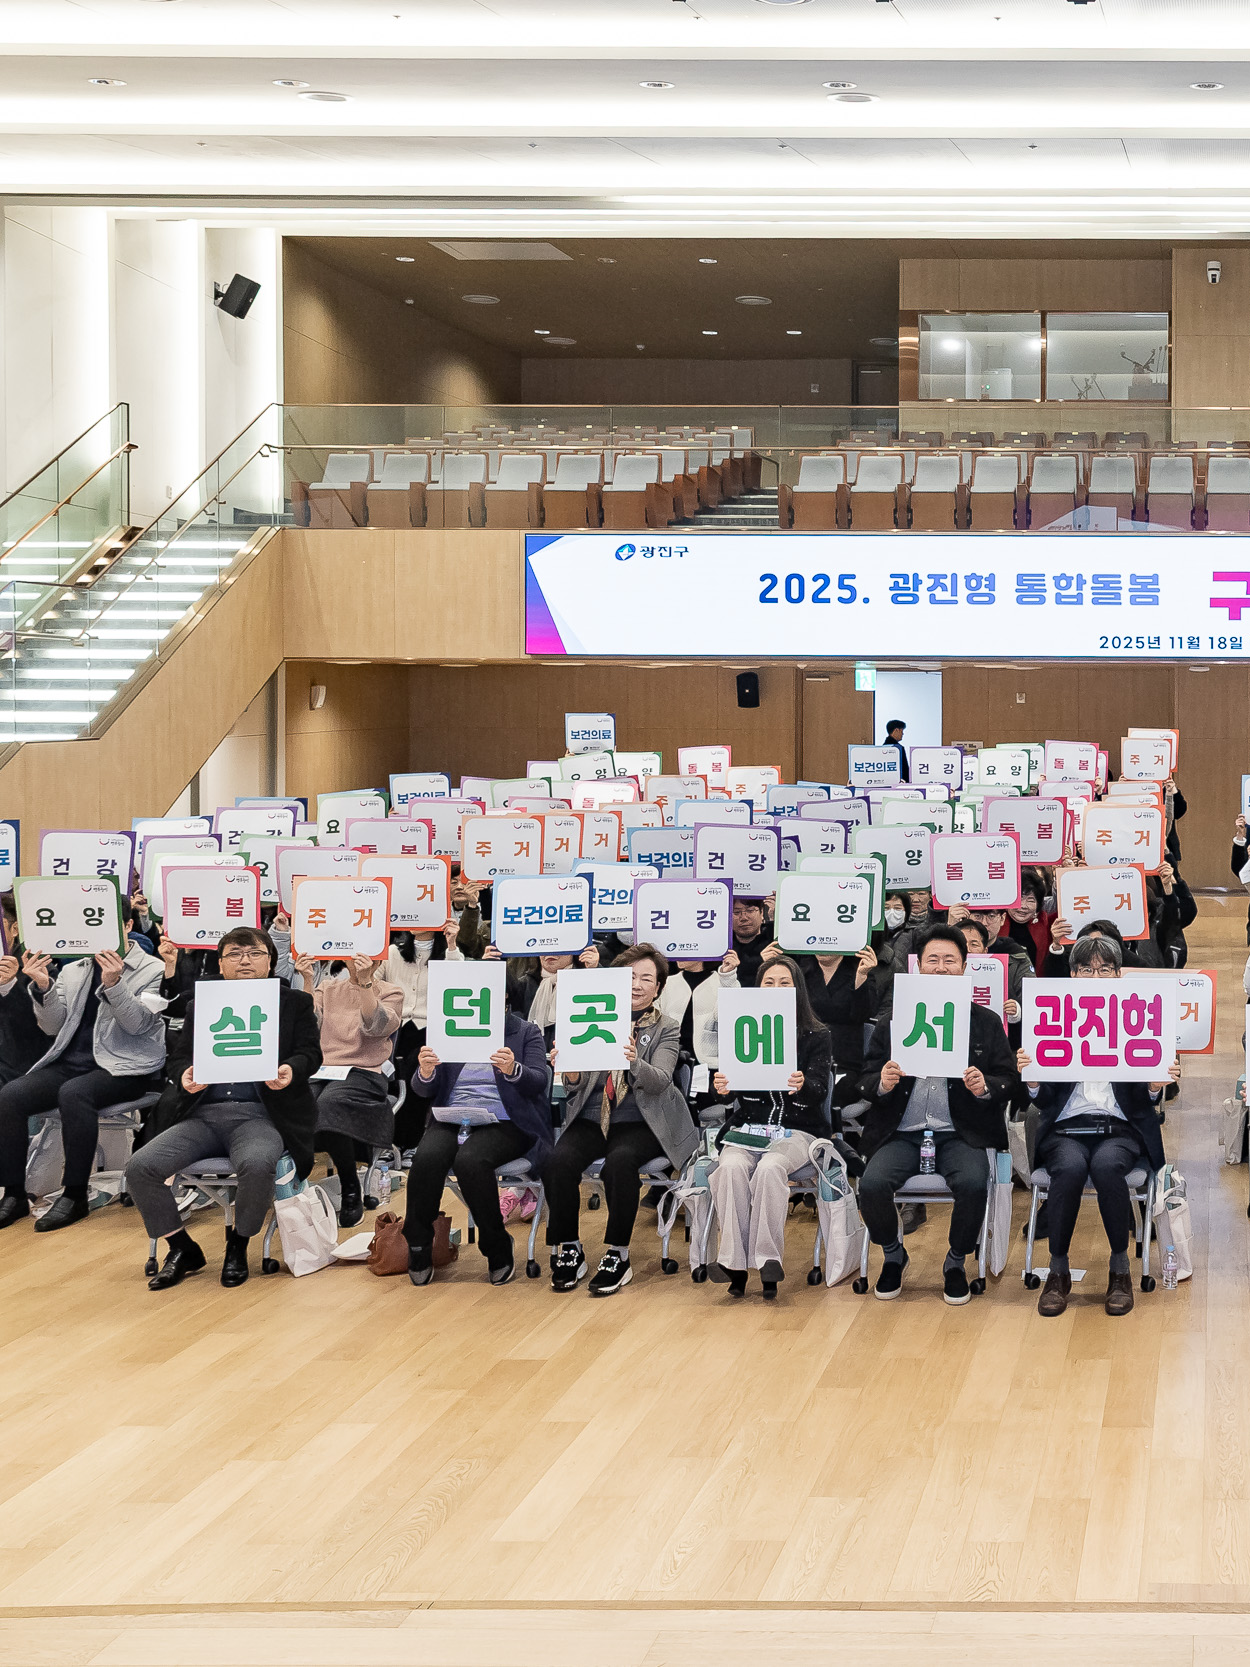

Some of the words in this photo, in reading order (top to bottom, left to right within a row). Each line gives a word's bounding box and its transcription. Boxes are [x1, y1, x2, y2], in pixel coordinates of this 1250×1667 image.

[640, 546, 689, 558] 광진구
[758, 572, 871, 604] 2025.
[888, 572, 997, 605] 광진형
[1015, 572, 1161, 605] 통합돌봄
[1099, 635, 1161, 650] 2025년
[1169, 635, 1200, 650] 11월
[1209, 635, 1243, 650] 18일
[570, 729, 612, 740] 보건의료
[854, 761, 898, 773] 보건의료
[502, 904, 583, 925] 보건의료
[209, 1005, 268, 1057] 살
[442, 987, 492, 1038] 던
[569, 993, 619, 1046] 곳
[902, 1001, 955, 1052] 서
[1033, 992, 1163, 1068] 광진형
[734, 1013, 785, 1065] 에
